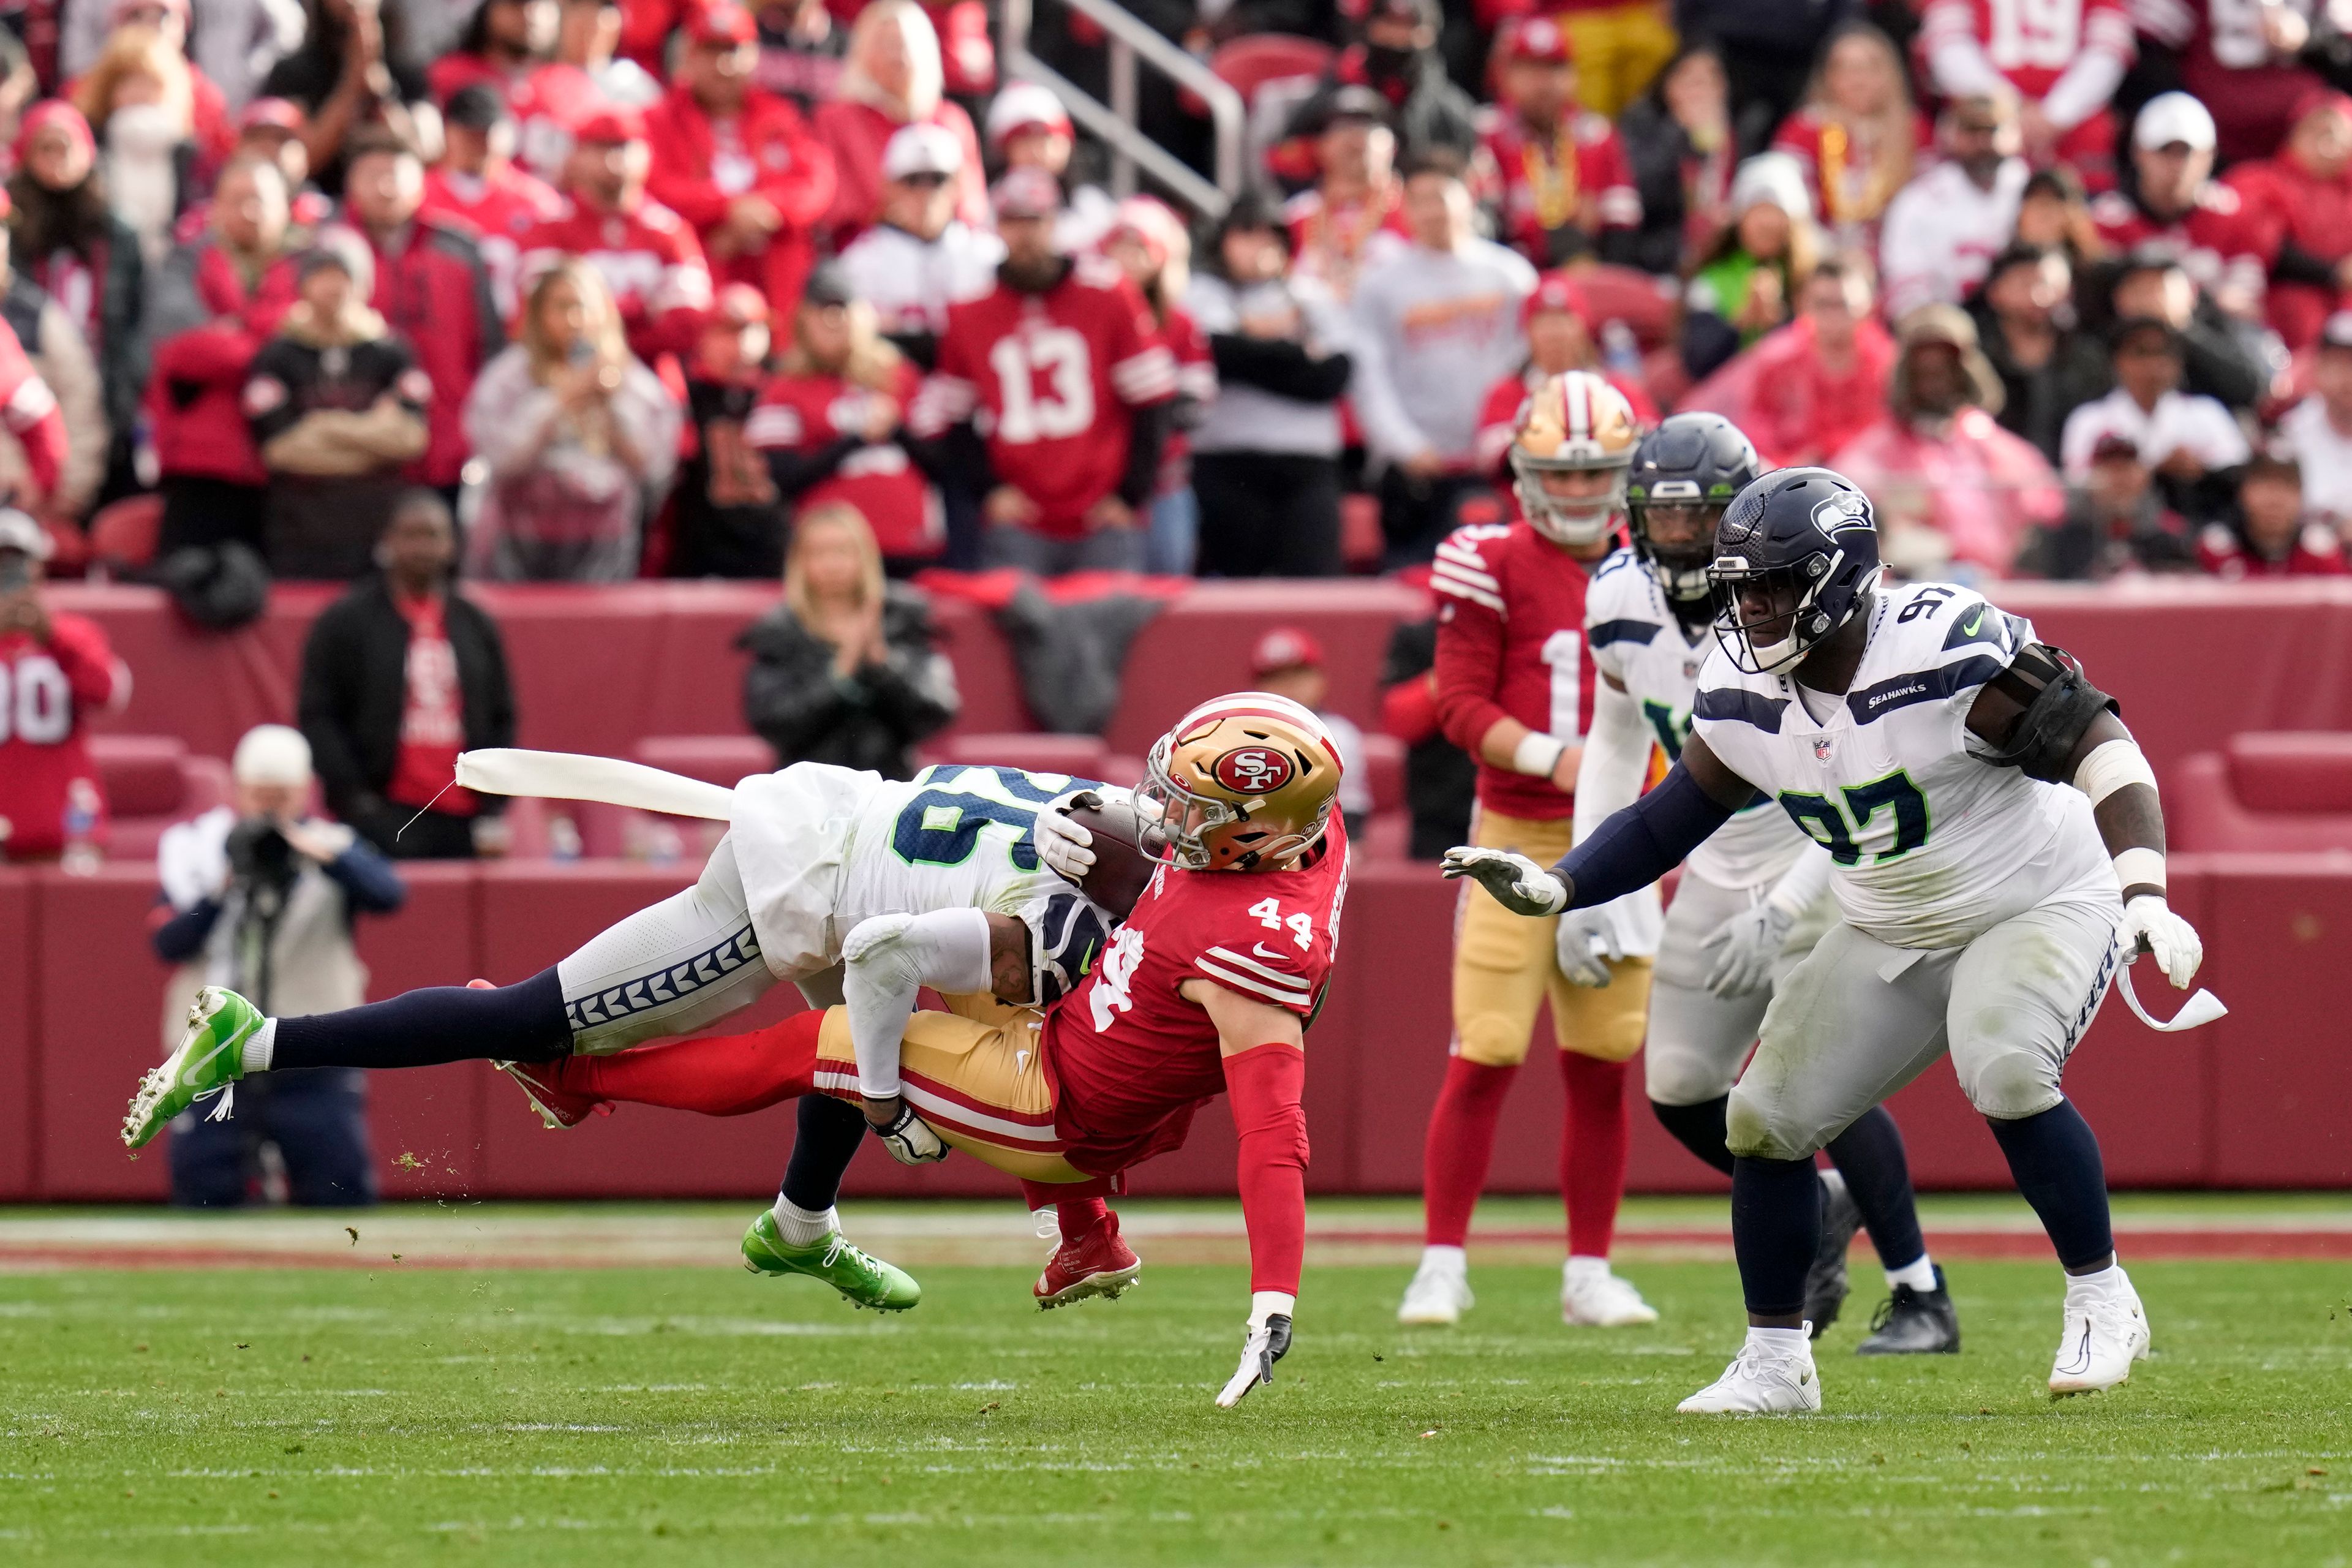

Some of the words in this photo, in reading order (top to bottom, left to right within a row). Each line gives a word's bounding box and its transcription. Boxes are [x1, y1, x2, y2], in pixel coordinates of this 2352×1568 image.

[989, 327, 1096, 445] 13
[1897, 587, 1956, 624] 97
[0, 657, 73, 745] 0
[1868, 683, 1927, 710] SEAHAWKS
[1234, 752, 1282, 790] SF
[1817, 747, 1830, 758] NFL
[1777, 767, 1931, 867] 97
[1248, 897, 1313, 952] 44
